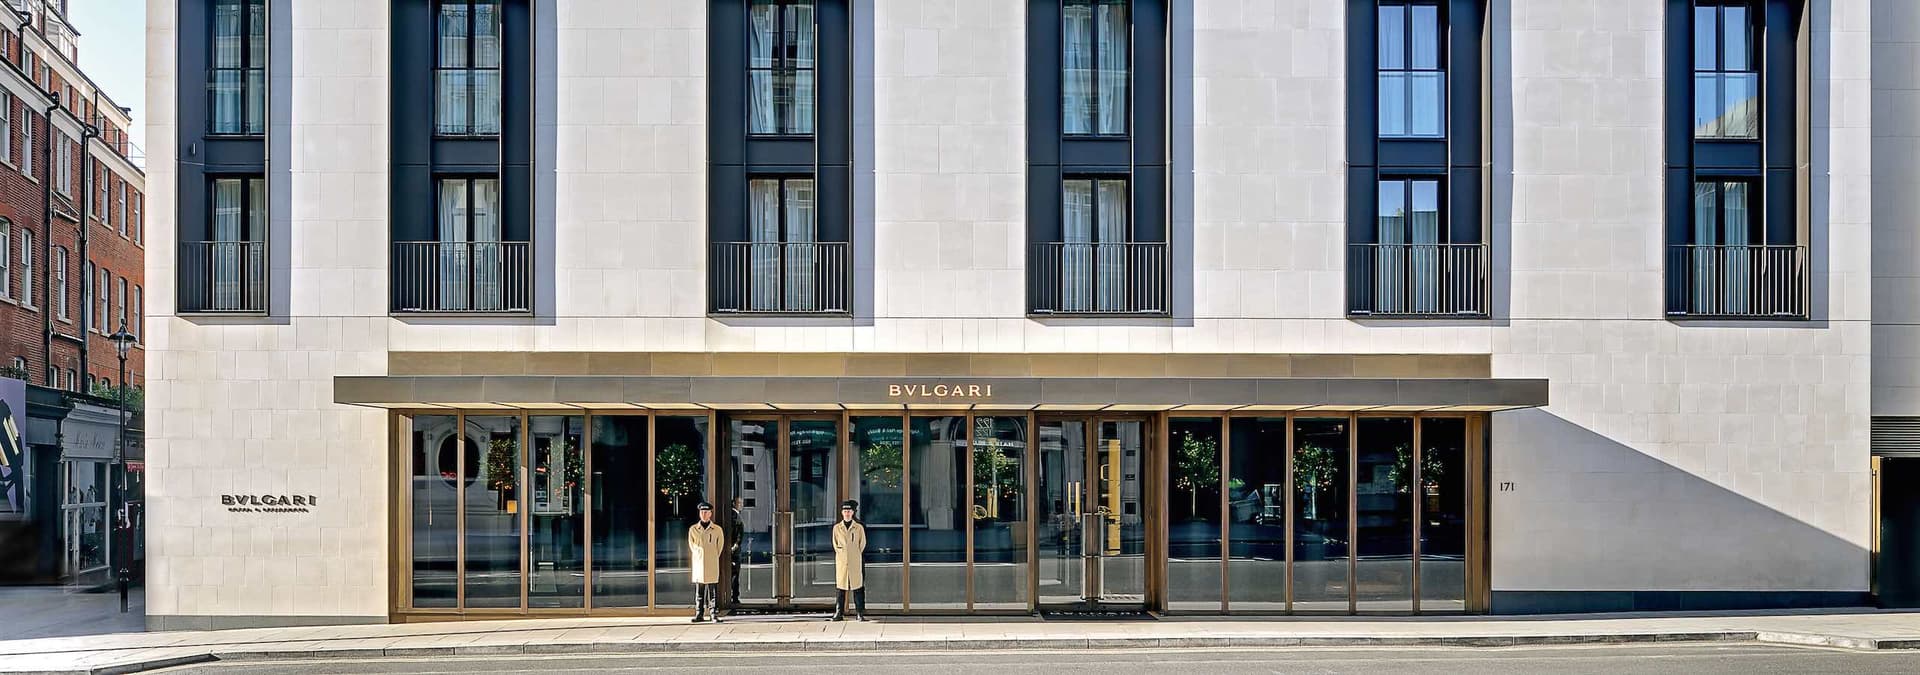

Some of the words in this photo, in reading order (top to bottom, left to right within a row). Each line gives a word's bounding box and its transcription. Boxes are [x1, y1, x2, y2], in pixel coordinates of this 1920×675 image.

[889, 384, 992, 397] BVLGARI
[1500, 482, 1514, 491] 171
[221, 494, 317, 506] BVLGARI
